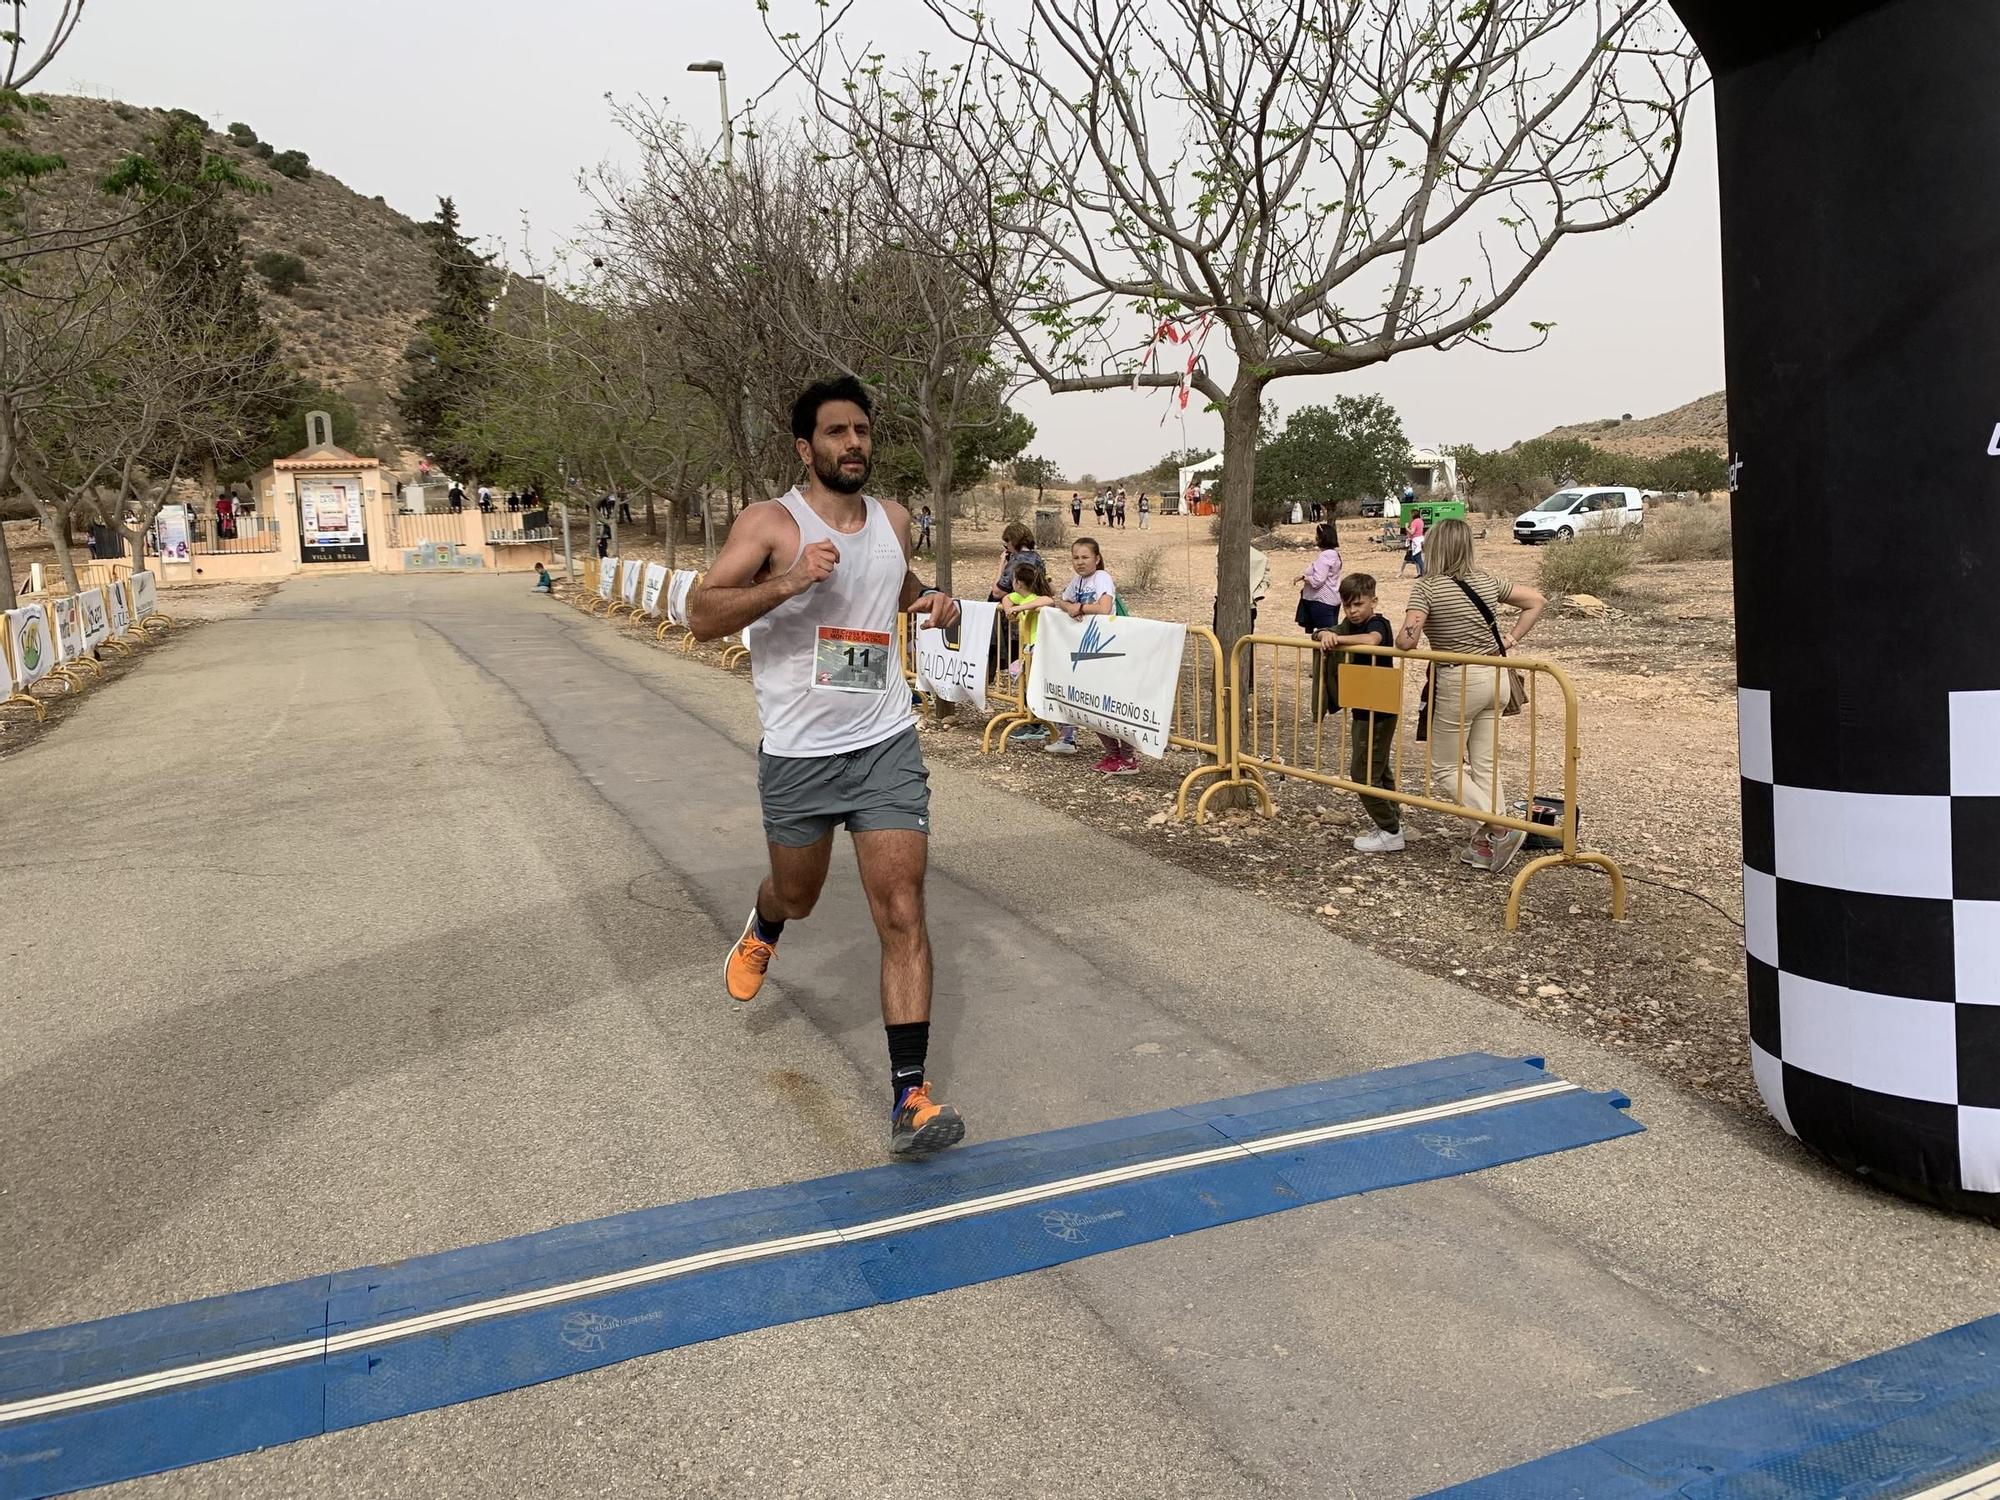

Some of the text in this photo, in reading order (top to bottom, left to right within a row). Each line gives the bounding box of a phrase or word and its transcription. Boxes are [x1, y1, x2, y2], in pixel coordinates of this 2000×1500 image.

[843, 647, 870, 668] 11
[1043, 701, 1159, 746] ANIDAD VEGETAL
[1044, 678, 1161, 726] IGUEL MORENO MEROÑO S.L.
